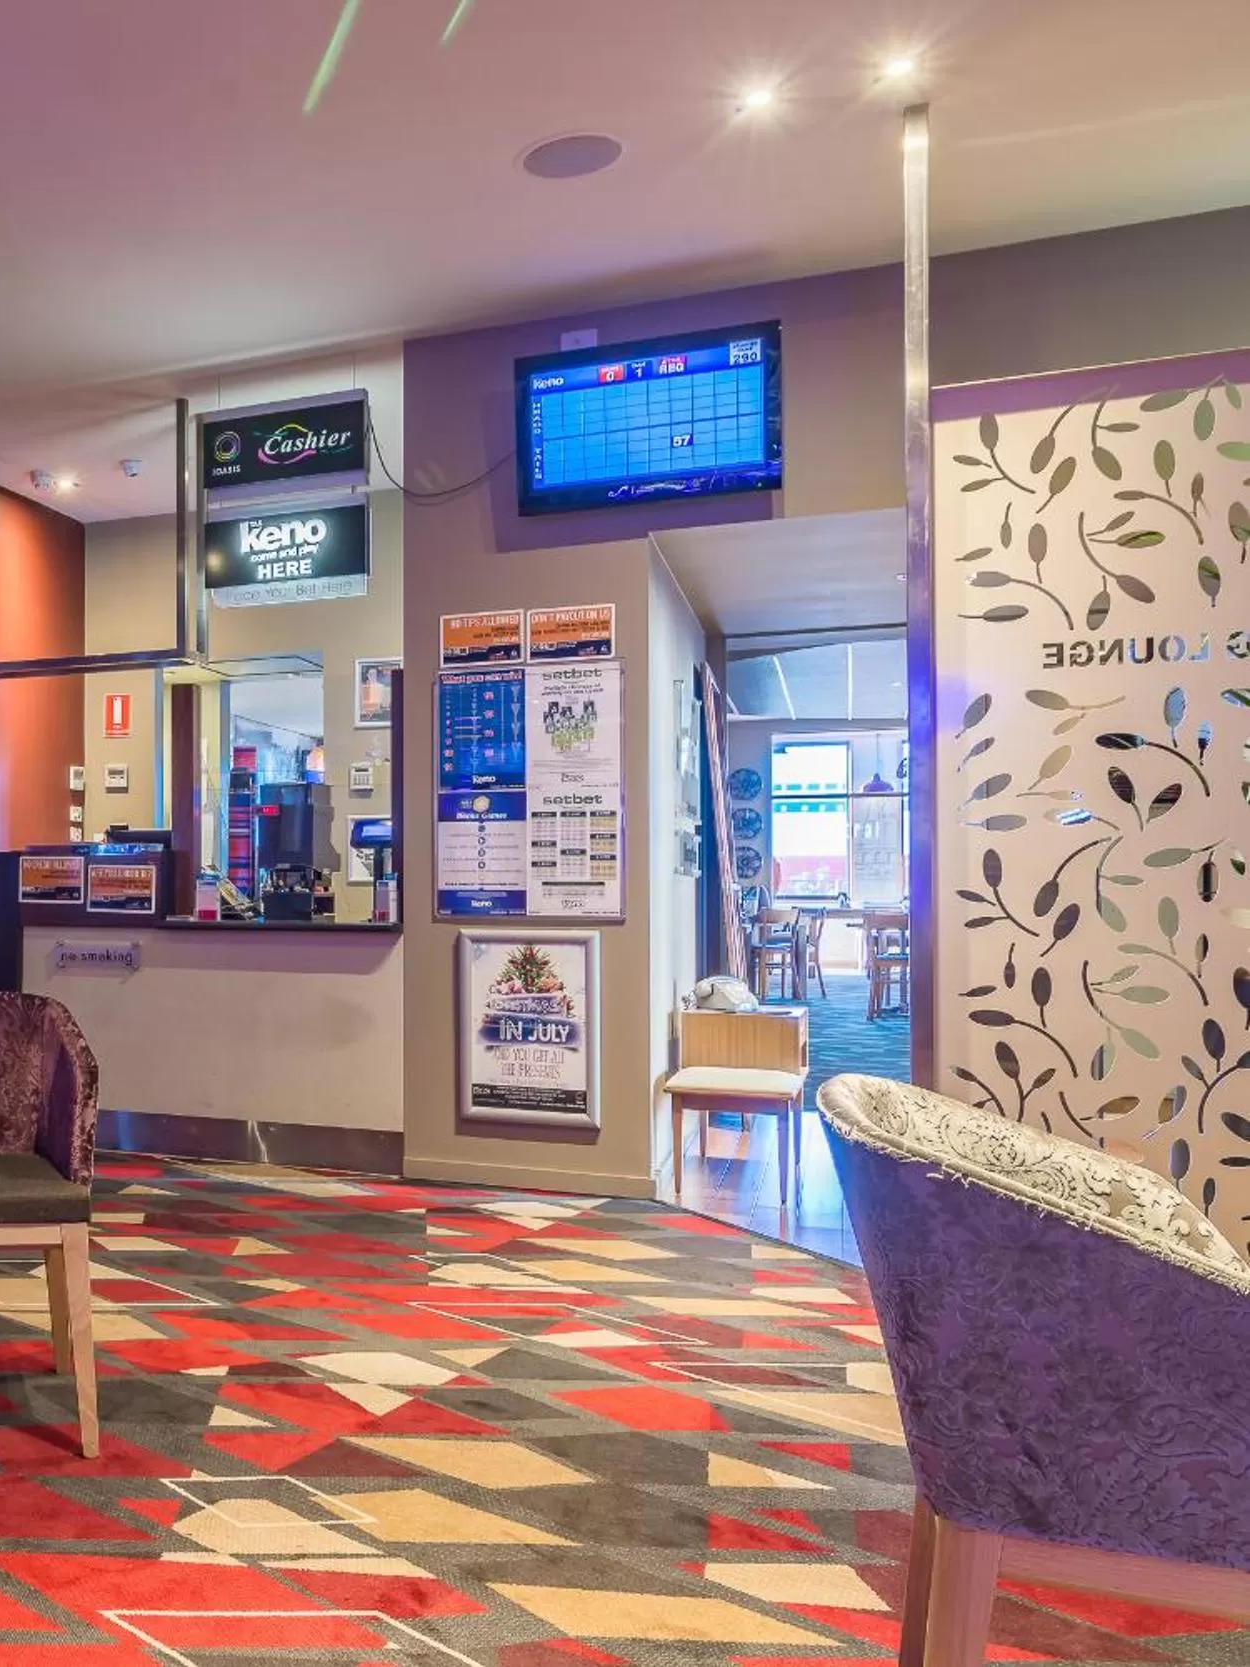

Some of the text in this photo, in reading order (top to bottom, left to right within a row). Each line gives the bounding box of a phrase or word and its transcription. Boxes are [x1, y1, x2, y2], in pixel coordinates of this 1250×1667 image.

[264, 429, 351, 455] Cashier
[672, 433, 692, 448] 57
[257, 559, 313, 580] HERE
[81, 949, 133, 966] smoking
[499, 1018, 570, 1043] IN JULY
